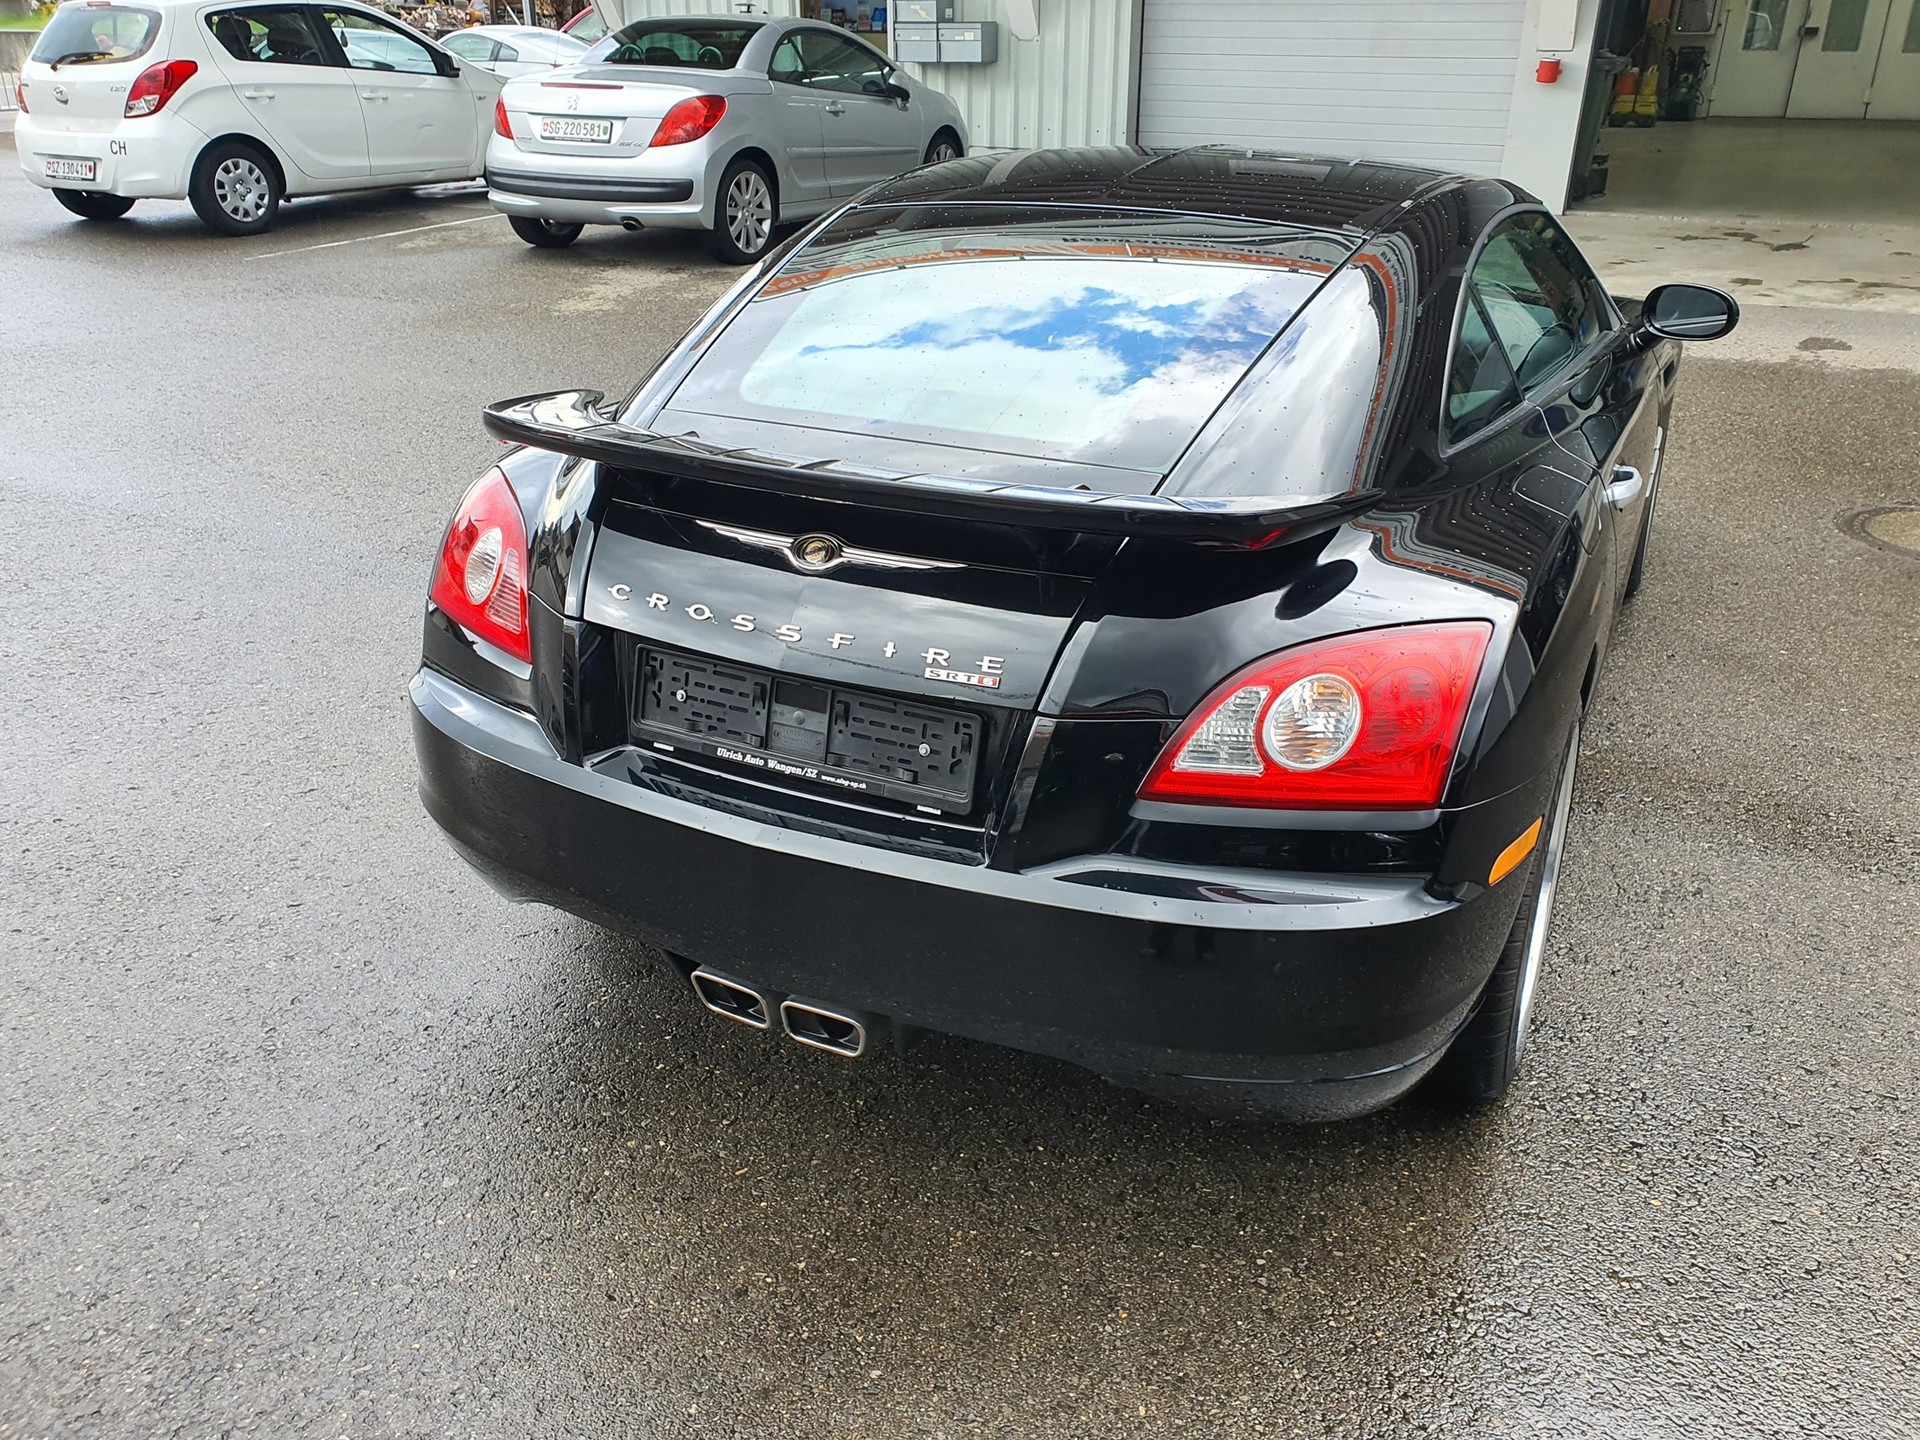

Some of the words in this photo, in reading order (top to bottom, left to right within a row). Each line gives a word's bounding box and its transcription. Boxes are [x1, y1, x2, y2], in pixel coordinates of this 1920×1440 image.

[109, 139, 128, 156] CH
[607, 583, 1005, 675] CROSSFIRE
[716, 747, 743, 762] Ulrich
[743, 753, 765, 767] Auto
[767, 758, 819, 779] Wangen/SZ
